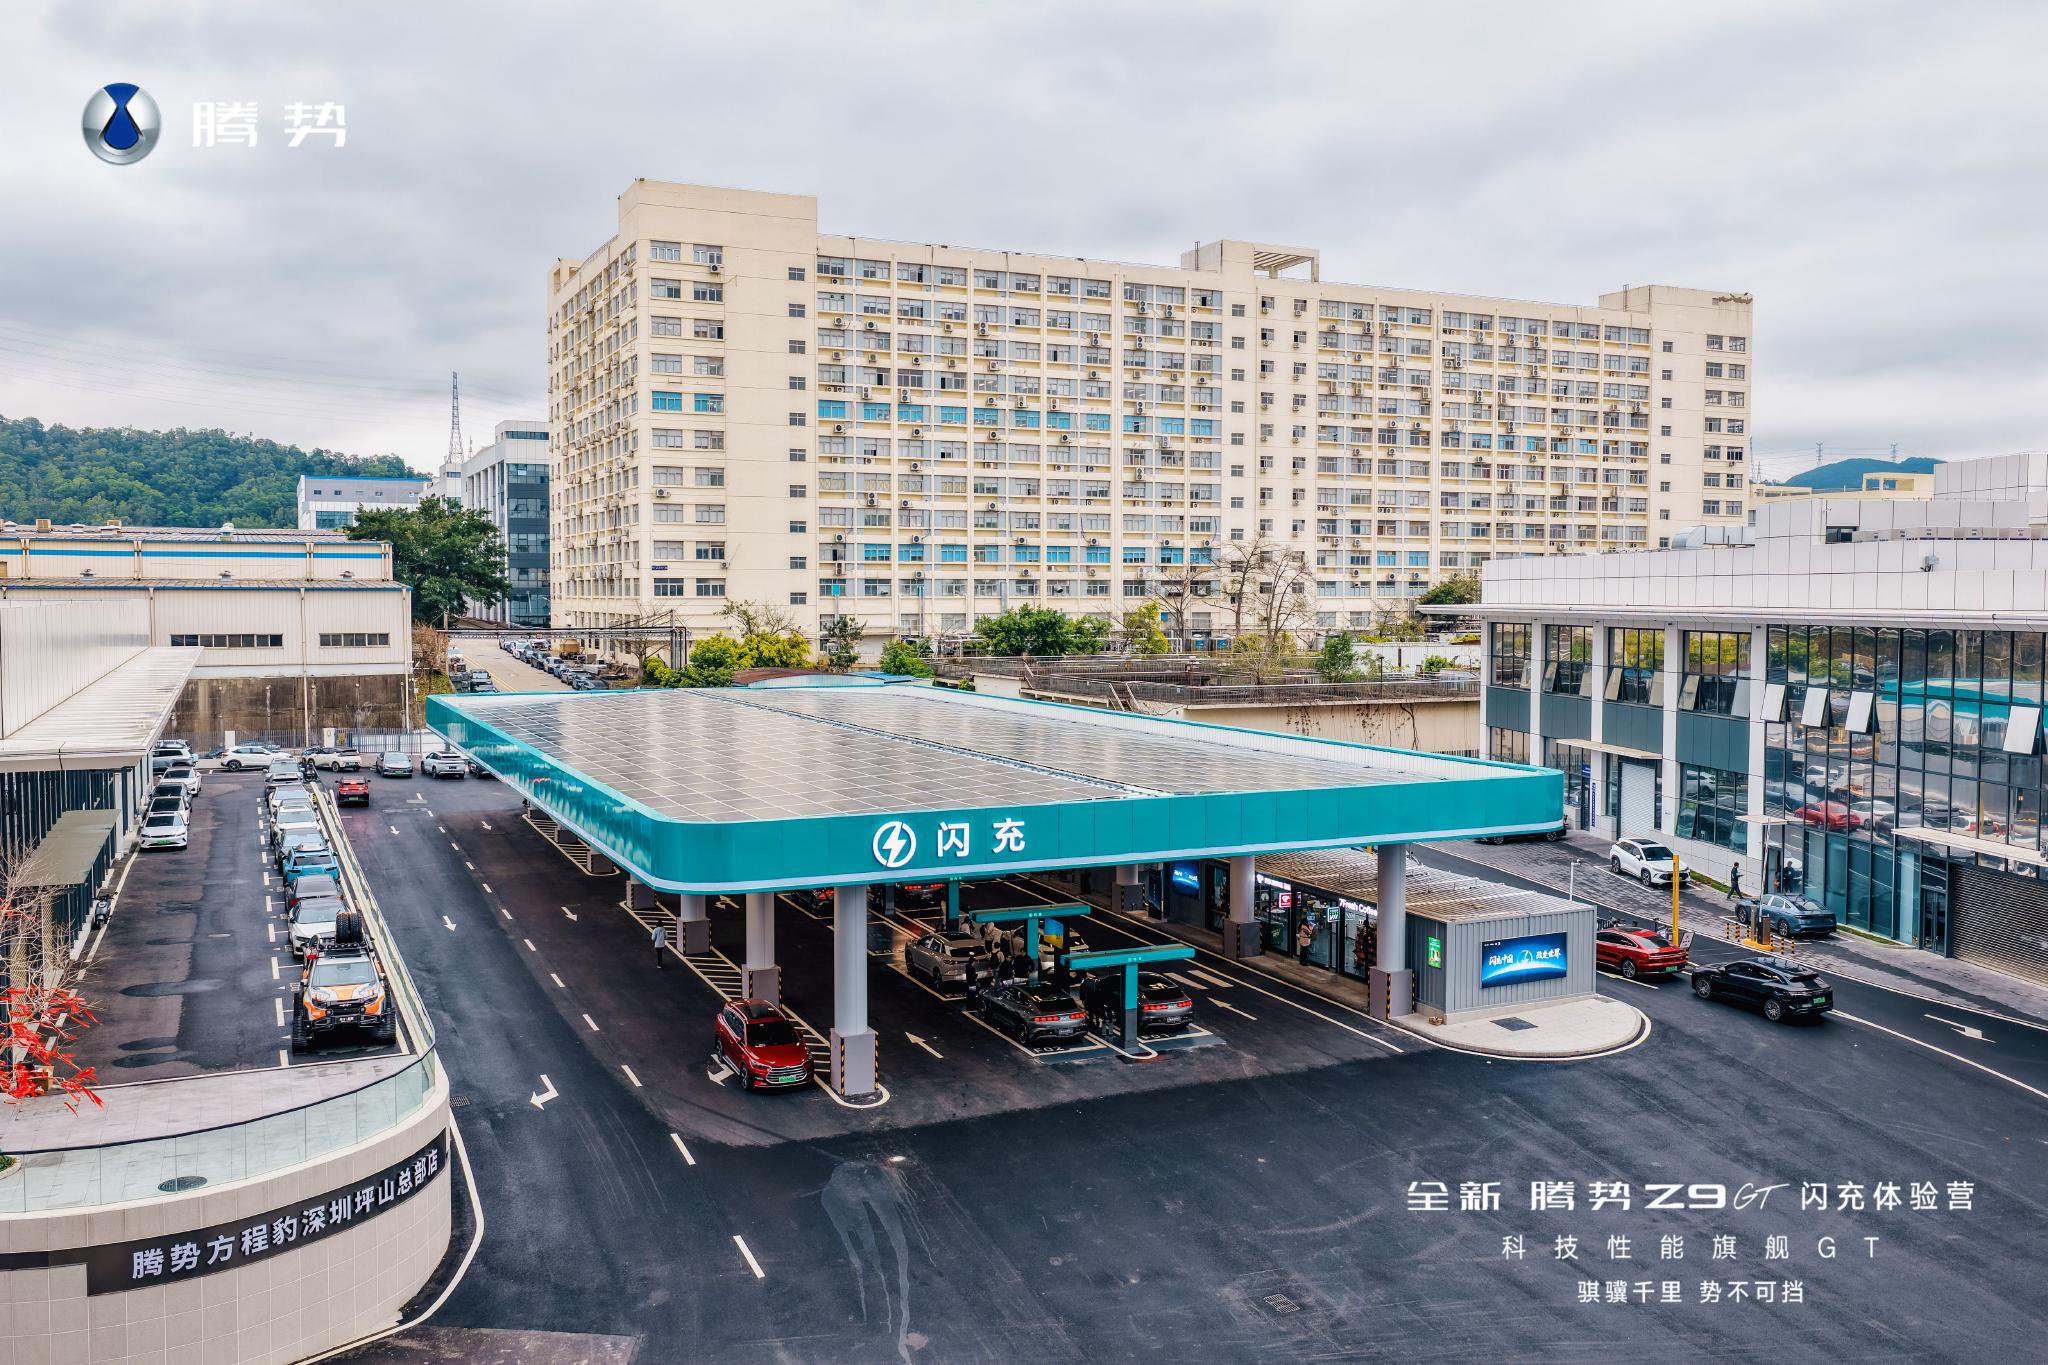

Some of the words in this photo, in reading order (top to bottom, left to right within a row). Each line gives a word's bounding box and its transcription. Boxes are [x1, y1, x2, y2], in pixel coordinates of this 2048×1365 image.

[937, 817, 1026, 858] 闪充
[131, 1148, 439, 1280] 腾势方程豹深圳坪山总部店
